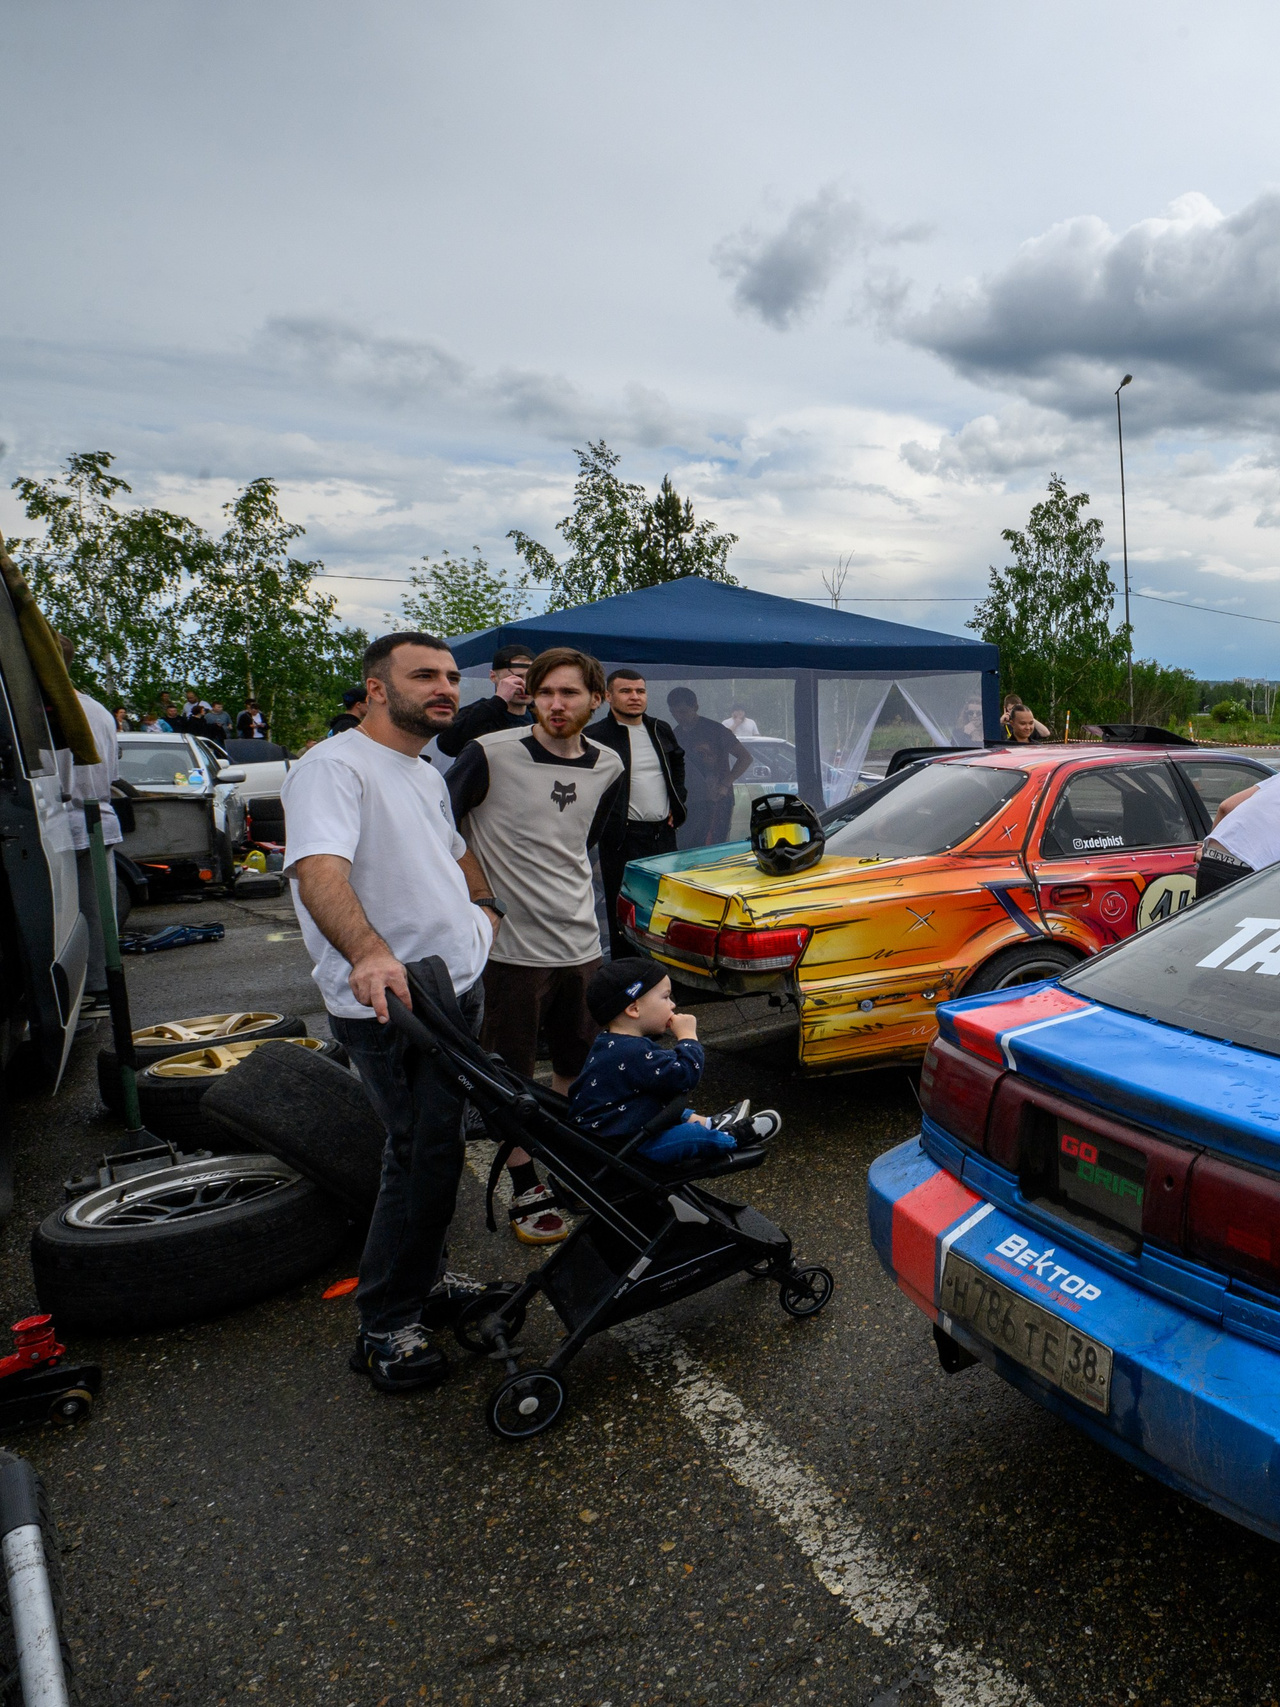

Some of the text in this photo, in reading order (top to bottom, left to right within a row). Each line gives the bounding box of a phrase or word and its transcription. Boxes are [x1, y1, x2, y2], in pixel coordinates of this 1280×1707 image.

[1083, 835, 1124, 849] xdelphist
[1061, 1134, 1098, 1165] GO
[1068, 1334, 1098, 1384] 38
